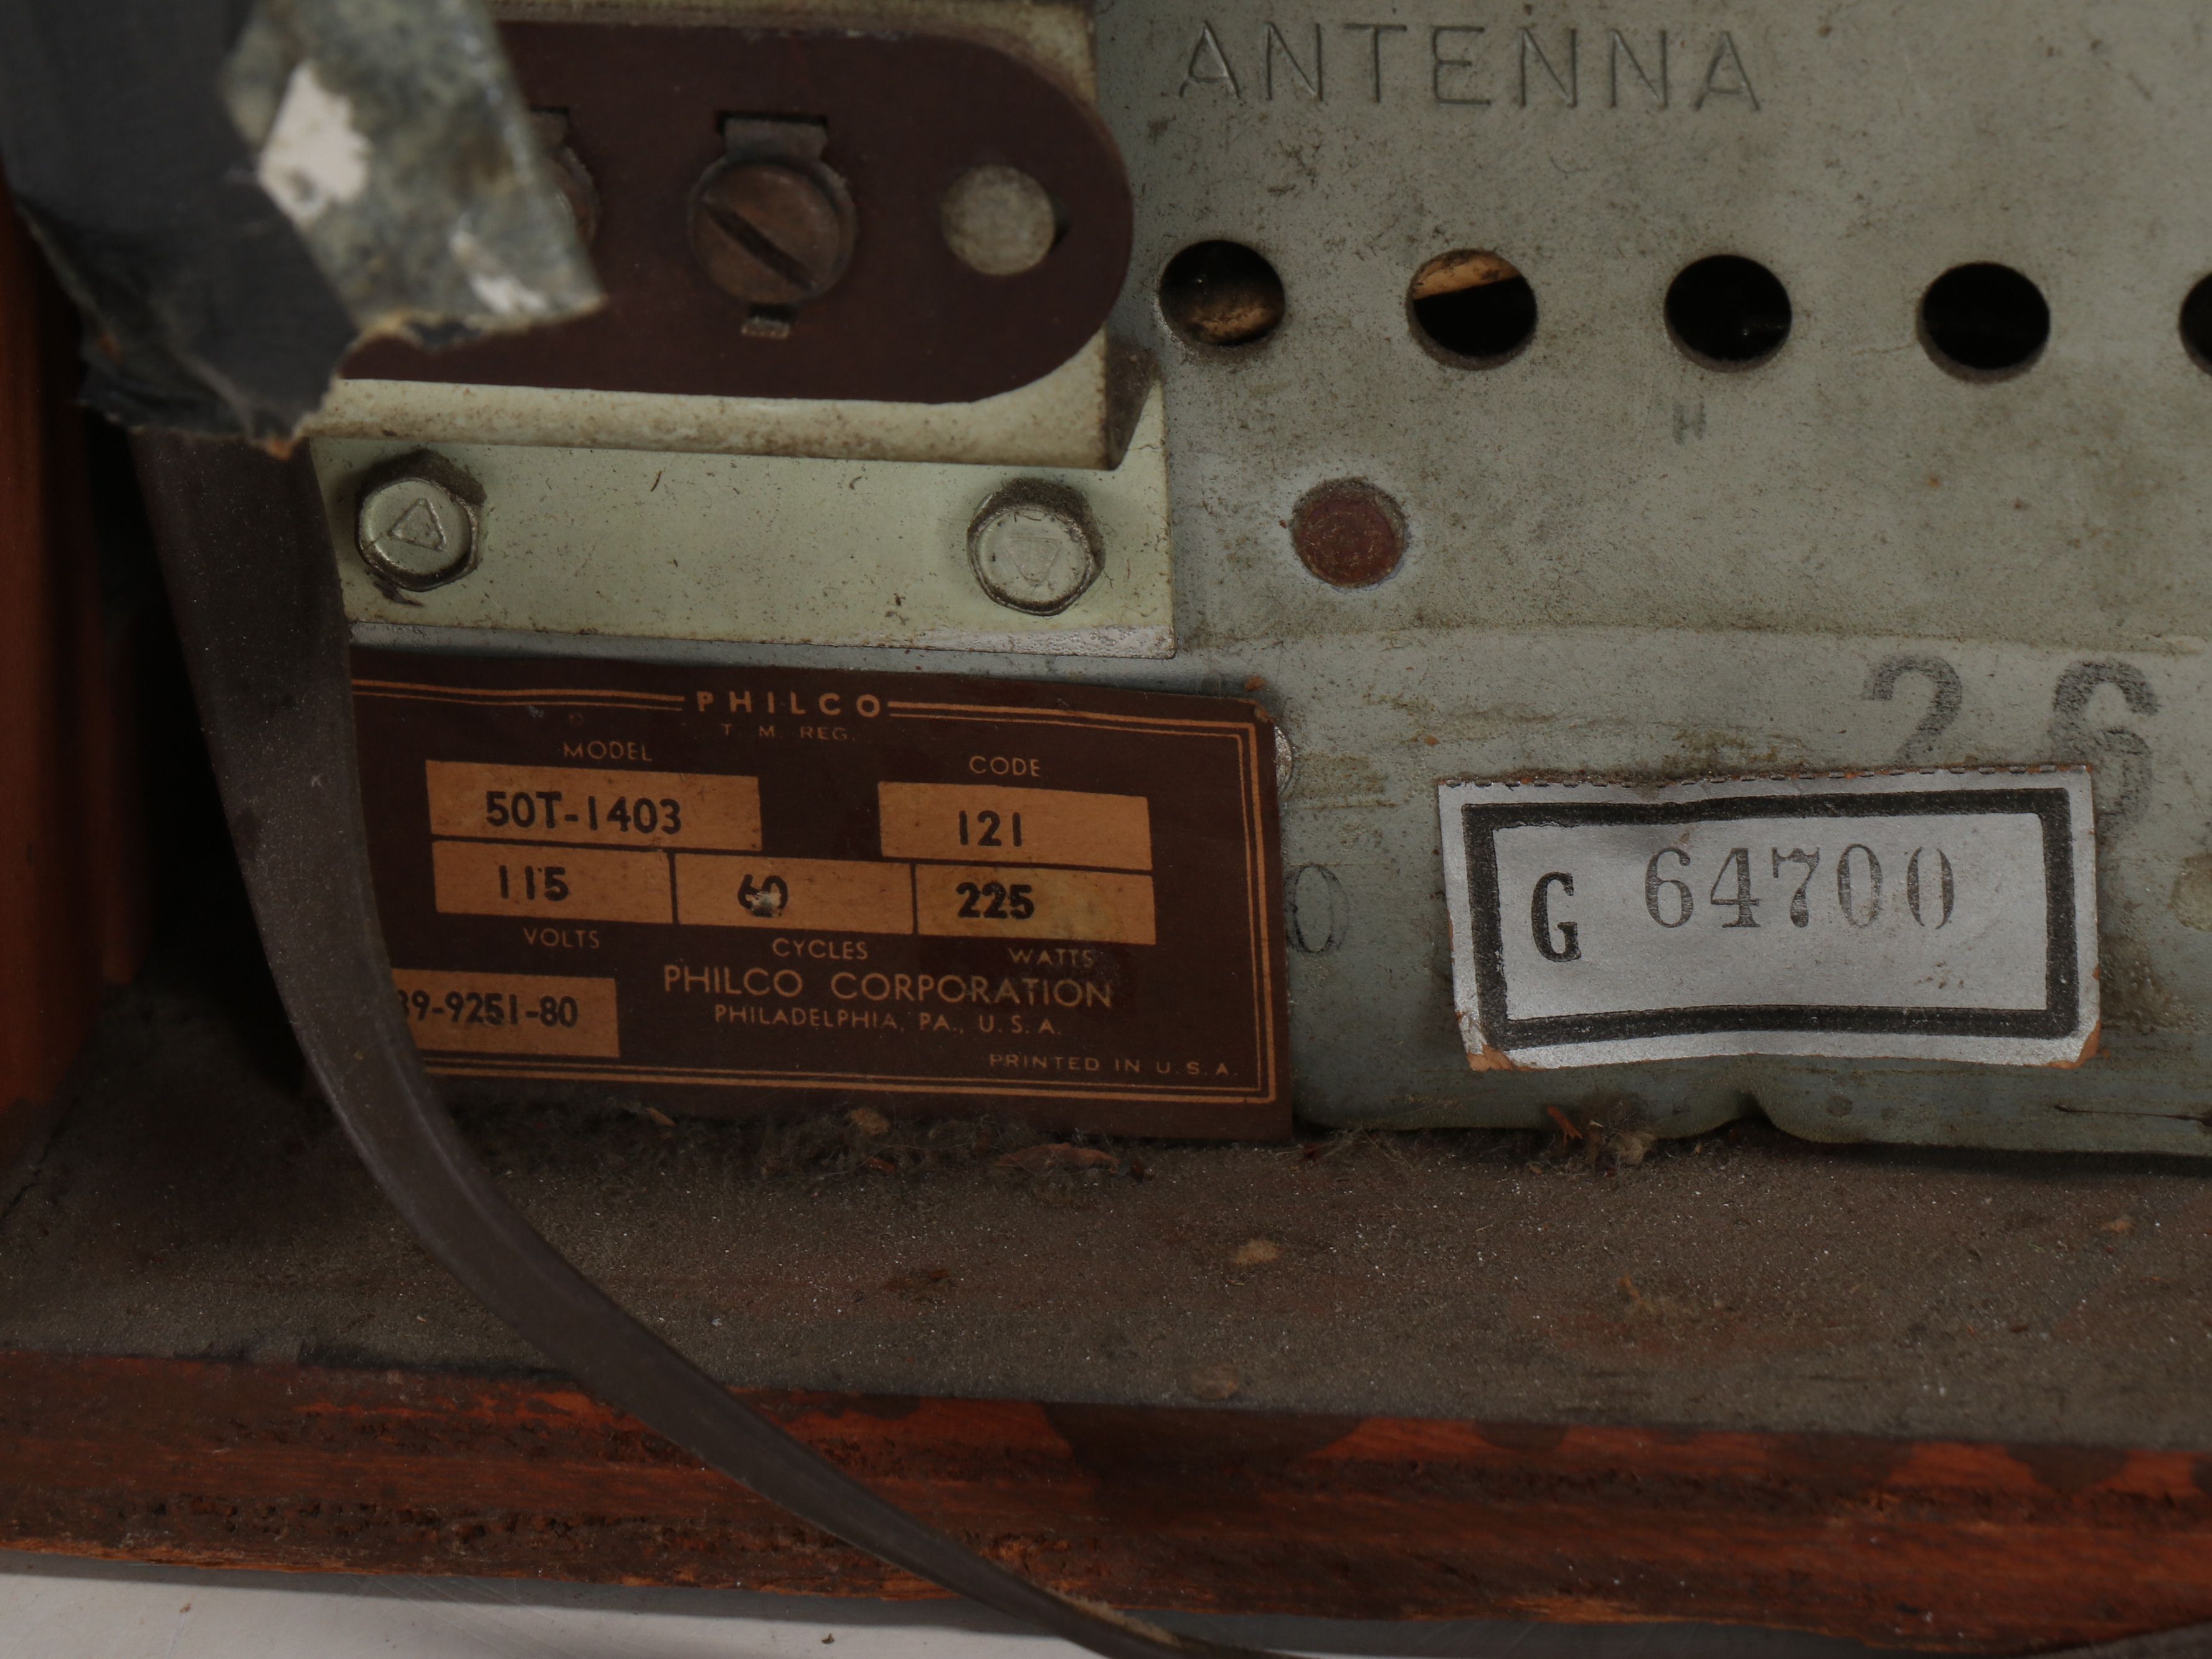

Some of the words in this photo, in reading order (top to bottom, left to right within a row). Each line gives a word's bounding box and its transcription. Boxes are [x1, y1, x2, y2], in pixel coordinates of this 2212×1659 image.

[1178, 21, 1760, 111] ANTENNA
[696, 691, 882, 718] PHILCO
[563, 740, 652, 762] MODEL
[969, 755, 1041, 777] CODE
[485, 790, 682, 834] 50T-1403
[958, 810, 1023, 847] 121
[500, 865, 569, 902] 115
[737, 874, 788, 918] 60
[956, 882, 1035, 920] 225
[1530, 871, 1583, 963] G
[1643, 842, 1955, 930] 64700
[524, 927, 601, 950] VOLTS
[772, 938, 869, 960] CYCLES
[1008, 947, 1095, 969] WATTS
[664, 964, 803, 997] PHILCO
[830, 971, 1113, 1008] CORPORATION
[715, 1003, 905, 1034] PHILADELPHIA,
[988, 1052, 1101, 1072] PRINTED
[1115, 1058, 1141, 1074] IN
